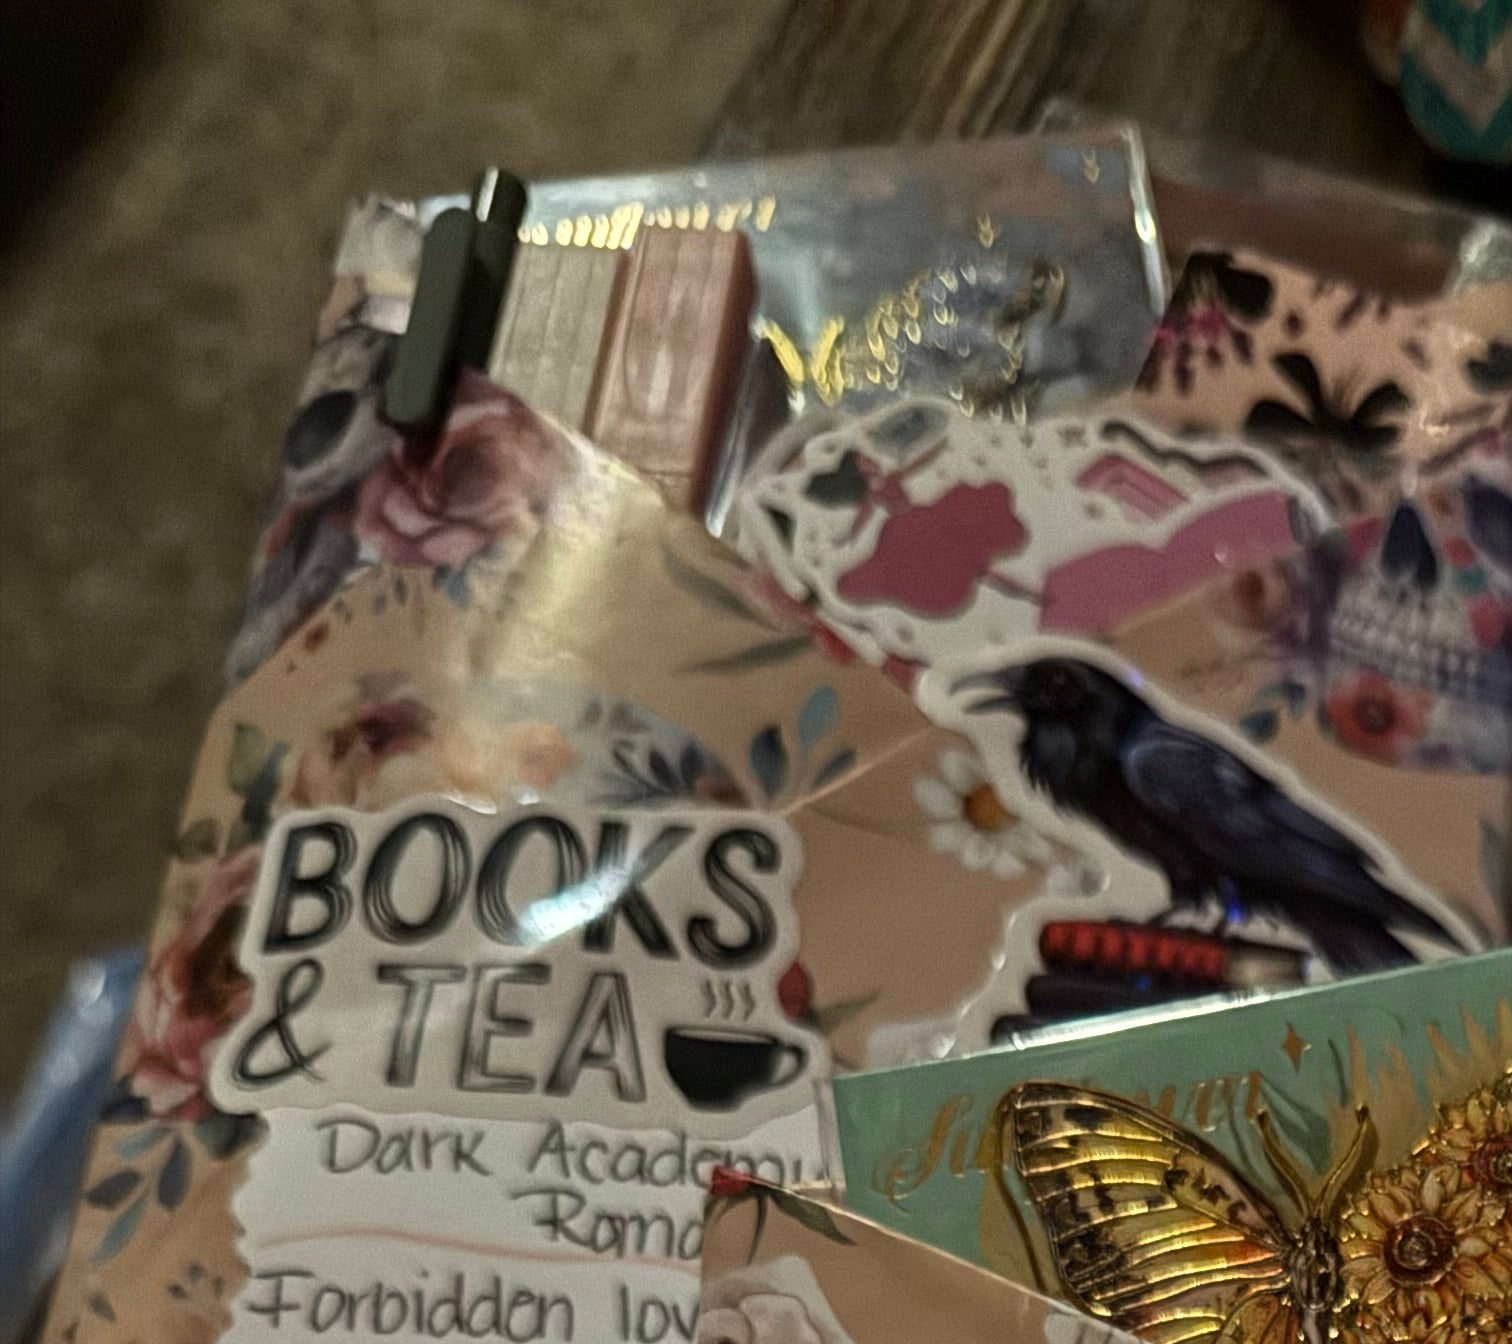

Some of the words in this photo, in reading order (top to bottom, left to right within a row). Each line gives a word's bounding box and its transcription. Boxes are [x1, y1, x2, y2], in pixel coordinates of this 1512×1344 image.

[262, 811, 783, 970] BOOKS
[231, 957, 334, 1090] &
[376, 961, 648, 1102] TEA
[316, 1119, 494, 1177] Dark
[245, 1266, 575, 1343] Forbidden
